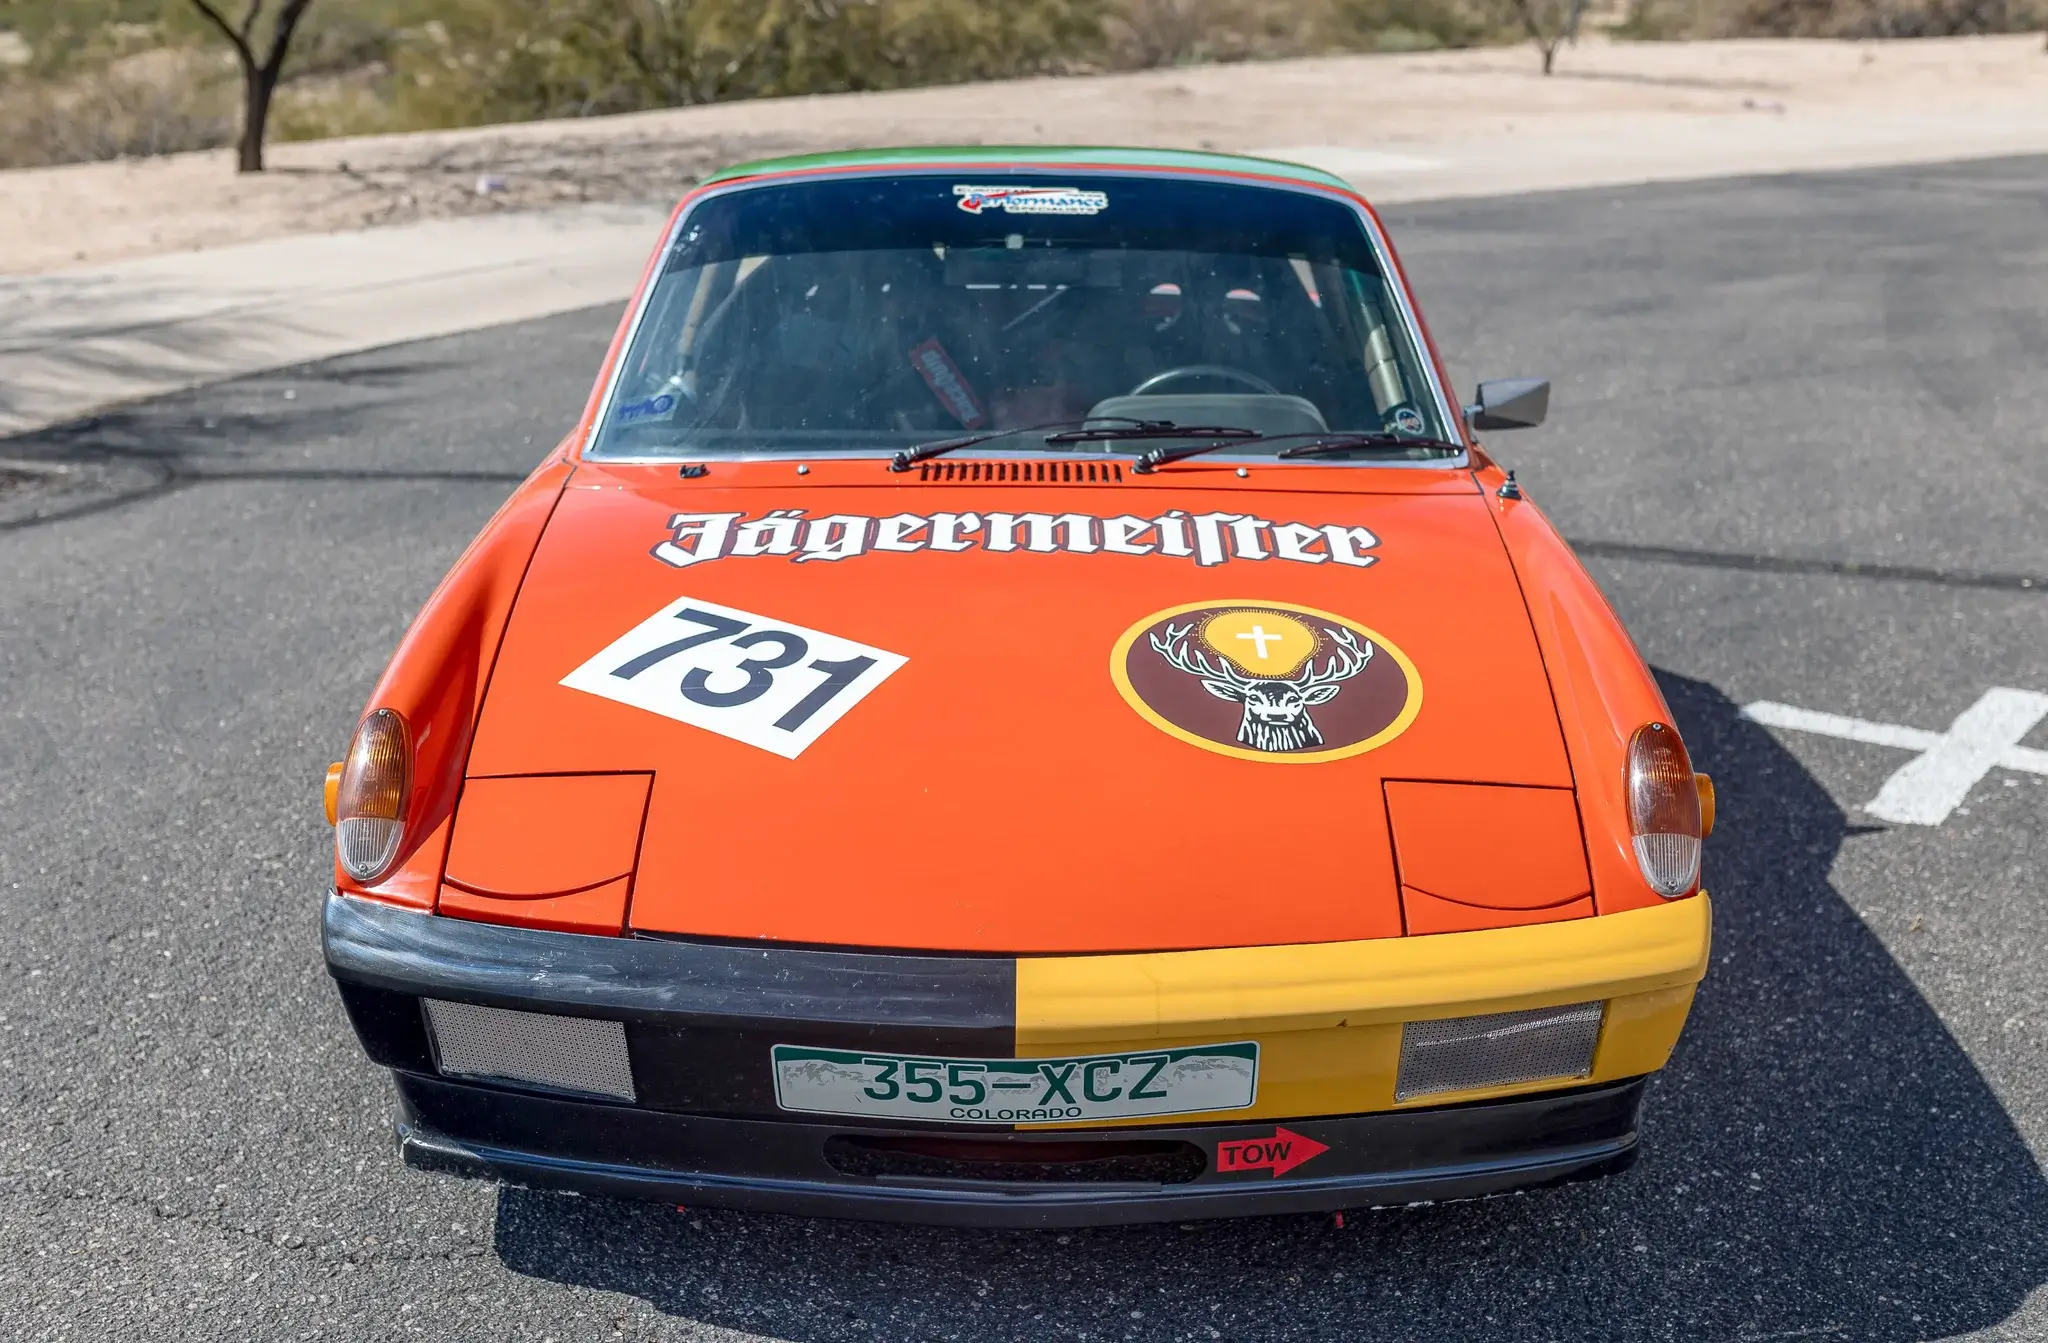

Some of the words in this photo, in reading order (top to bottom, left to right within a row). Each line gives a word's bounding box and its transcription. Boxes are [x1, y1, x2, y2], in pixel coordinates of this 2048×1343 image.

[609, 607, 879, 733] 731
[862, 1054, 1170, 1107] 355-XCZ
[949, 1106, 1083, 1120] COLORADO
[1223, 1141, 1294, 1166] TOW
